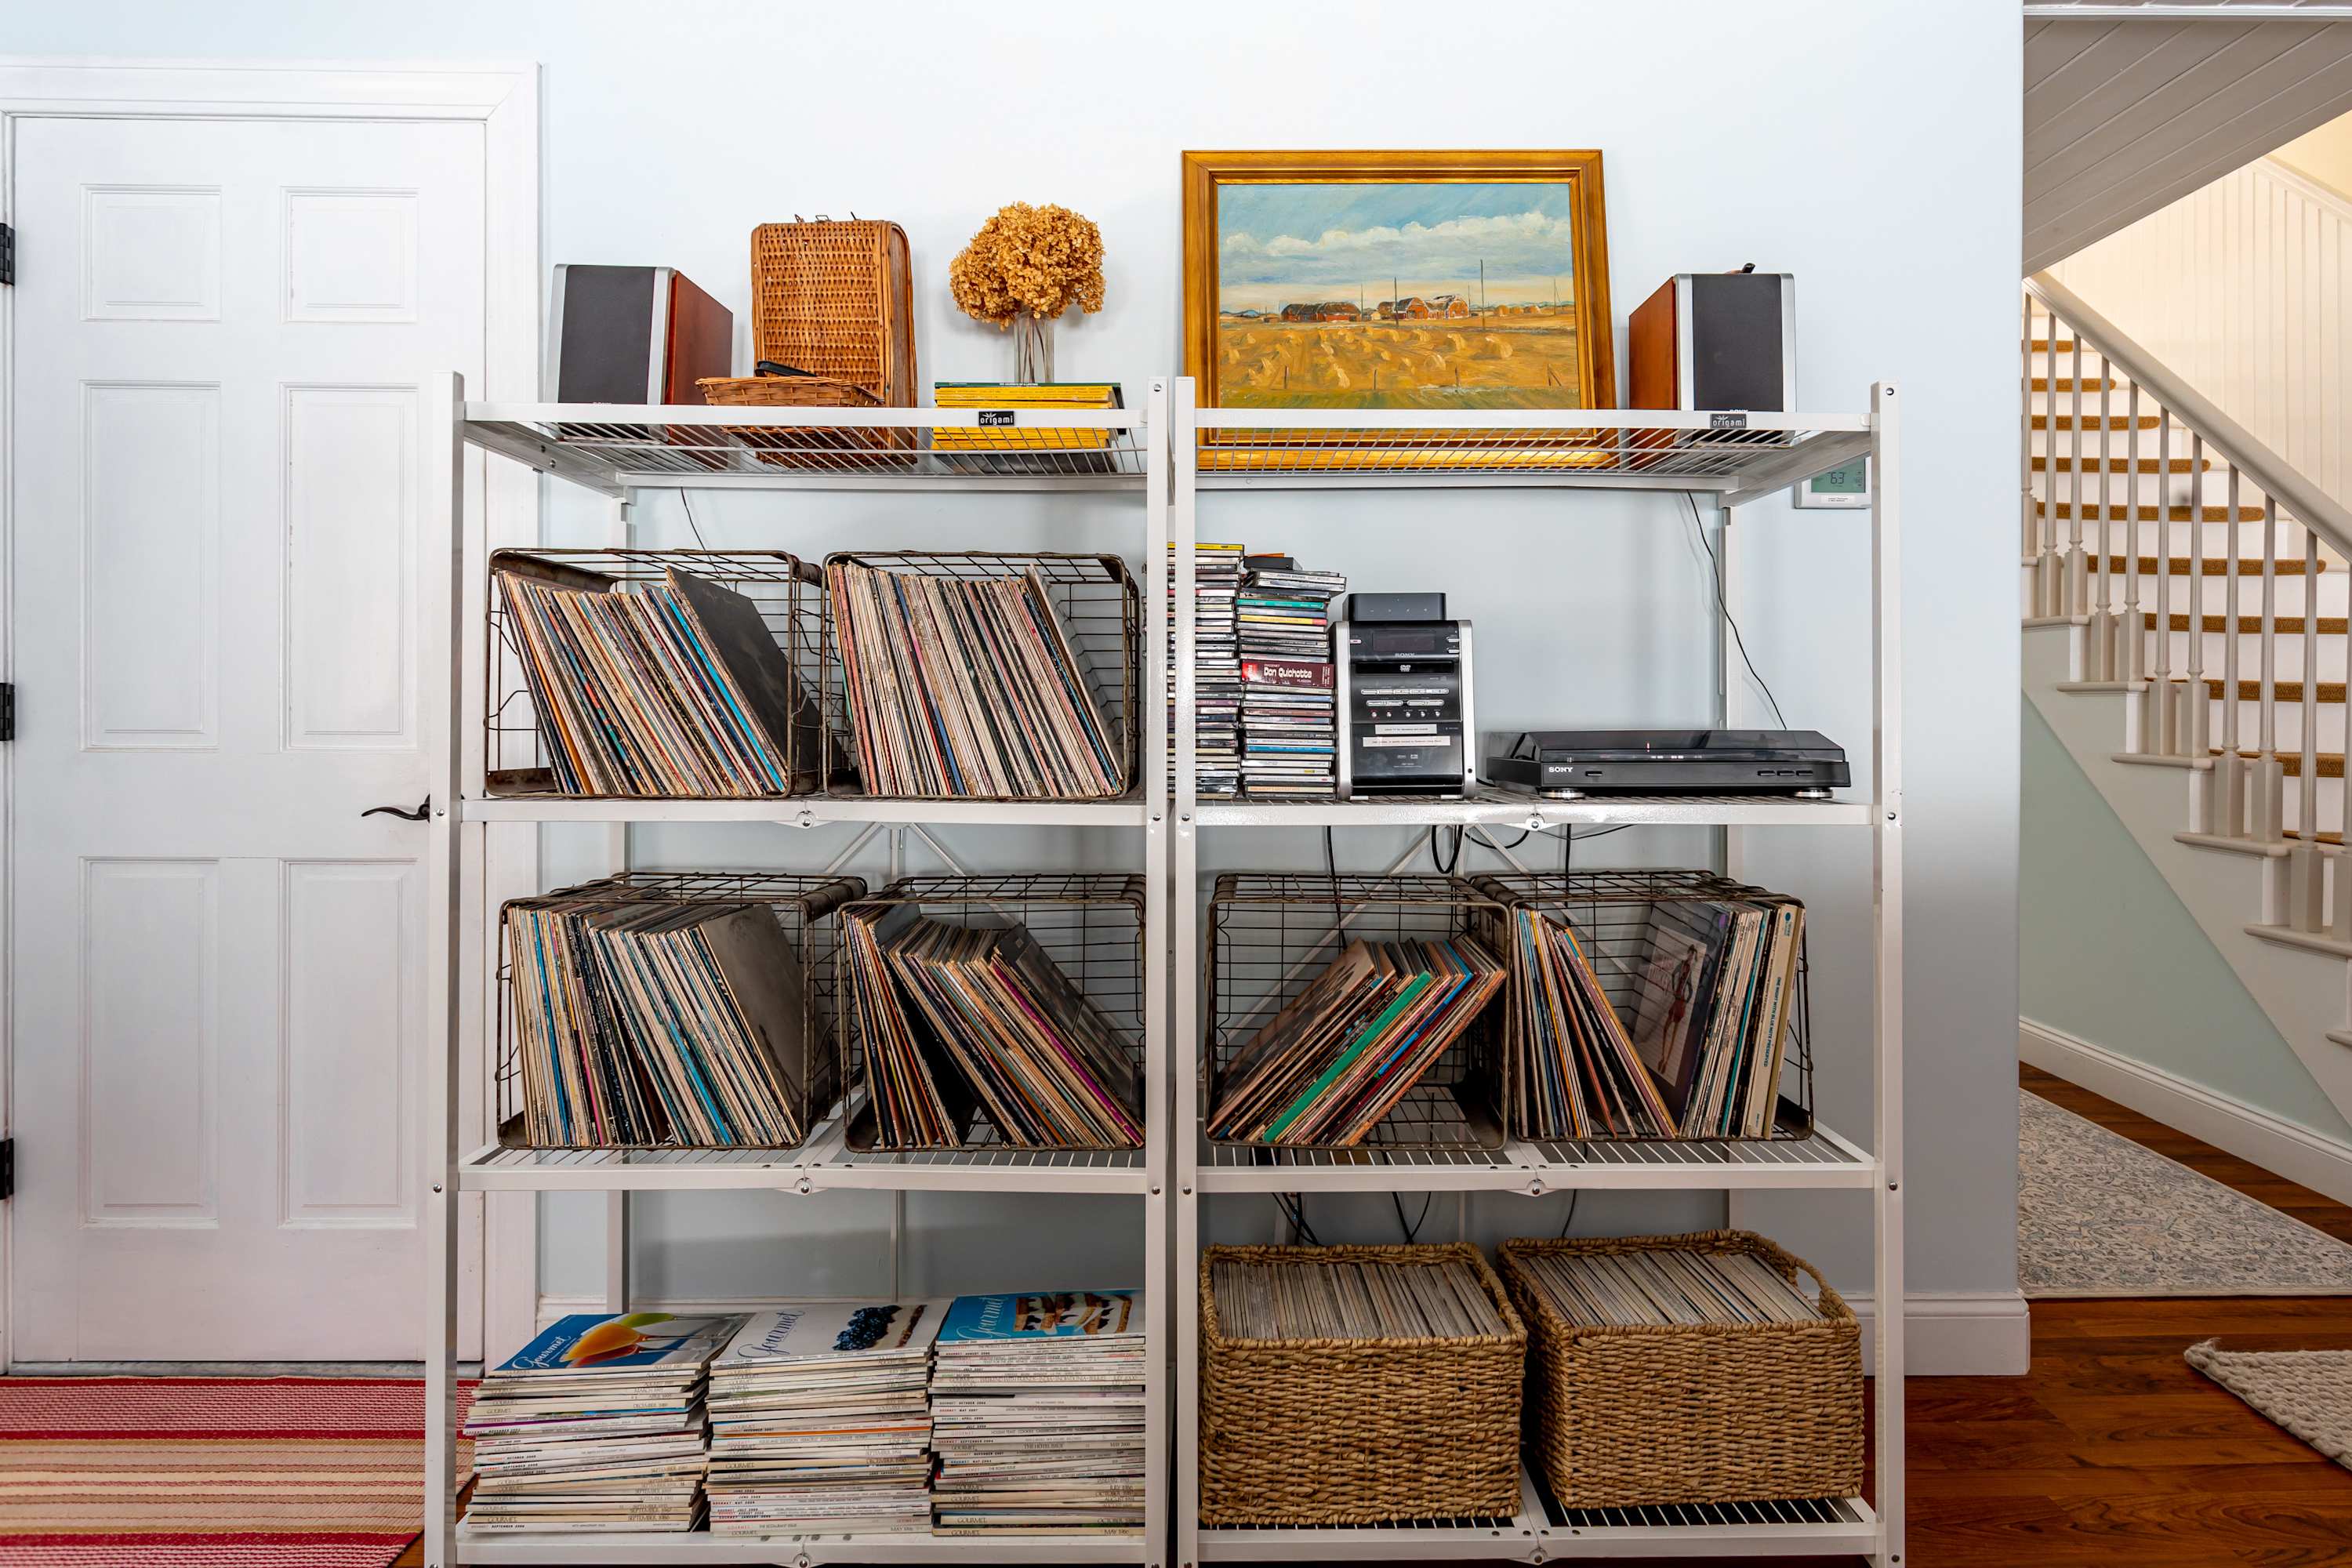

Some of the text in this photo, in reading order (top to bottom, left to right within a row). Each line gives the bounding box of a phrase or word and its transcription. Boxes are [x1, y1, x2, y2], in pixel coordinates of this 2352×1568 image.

[980, 415, 1013, 426] origami
[1712, 418, 1745, 428] origami
[1831, 472, 1845, 485] 63
[1264, 666, 1277, 677] Don
[1278, 666, 1312, 679] Quichotte
[956, 1297, 1011, 1340] Gourmet
[738, 1309, 805, 1358] Gourmet
[512, 1335, 572, 1369] Gourmet
